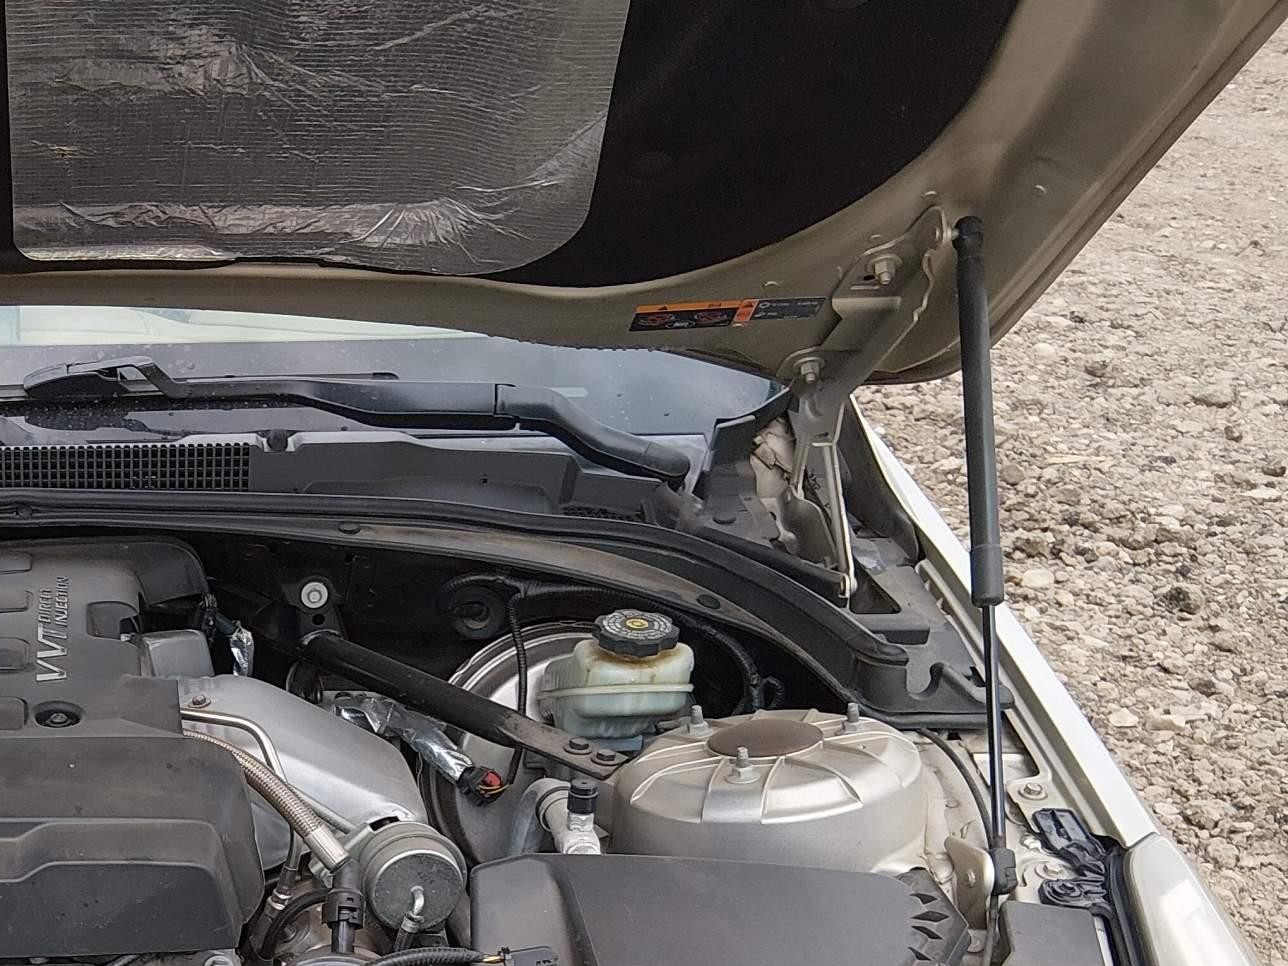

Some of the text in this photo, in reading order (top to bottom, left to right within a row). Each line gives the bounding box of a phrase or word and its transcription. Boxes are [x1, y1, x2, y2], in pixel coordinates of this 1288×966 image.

[38, 588, 52, 624] DIRECT
[55, 576, 69, 627] INJECTION
[36, 623, 68, 683] VVT
